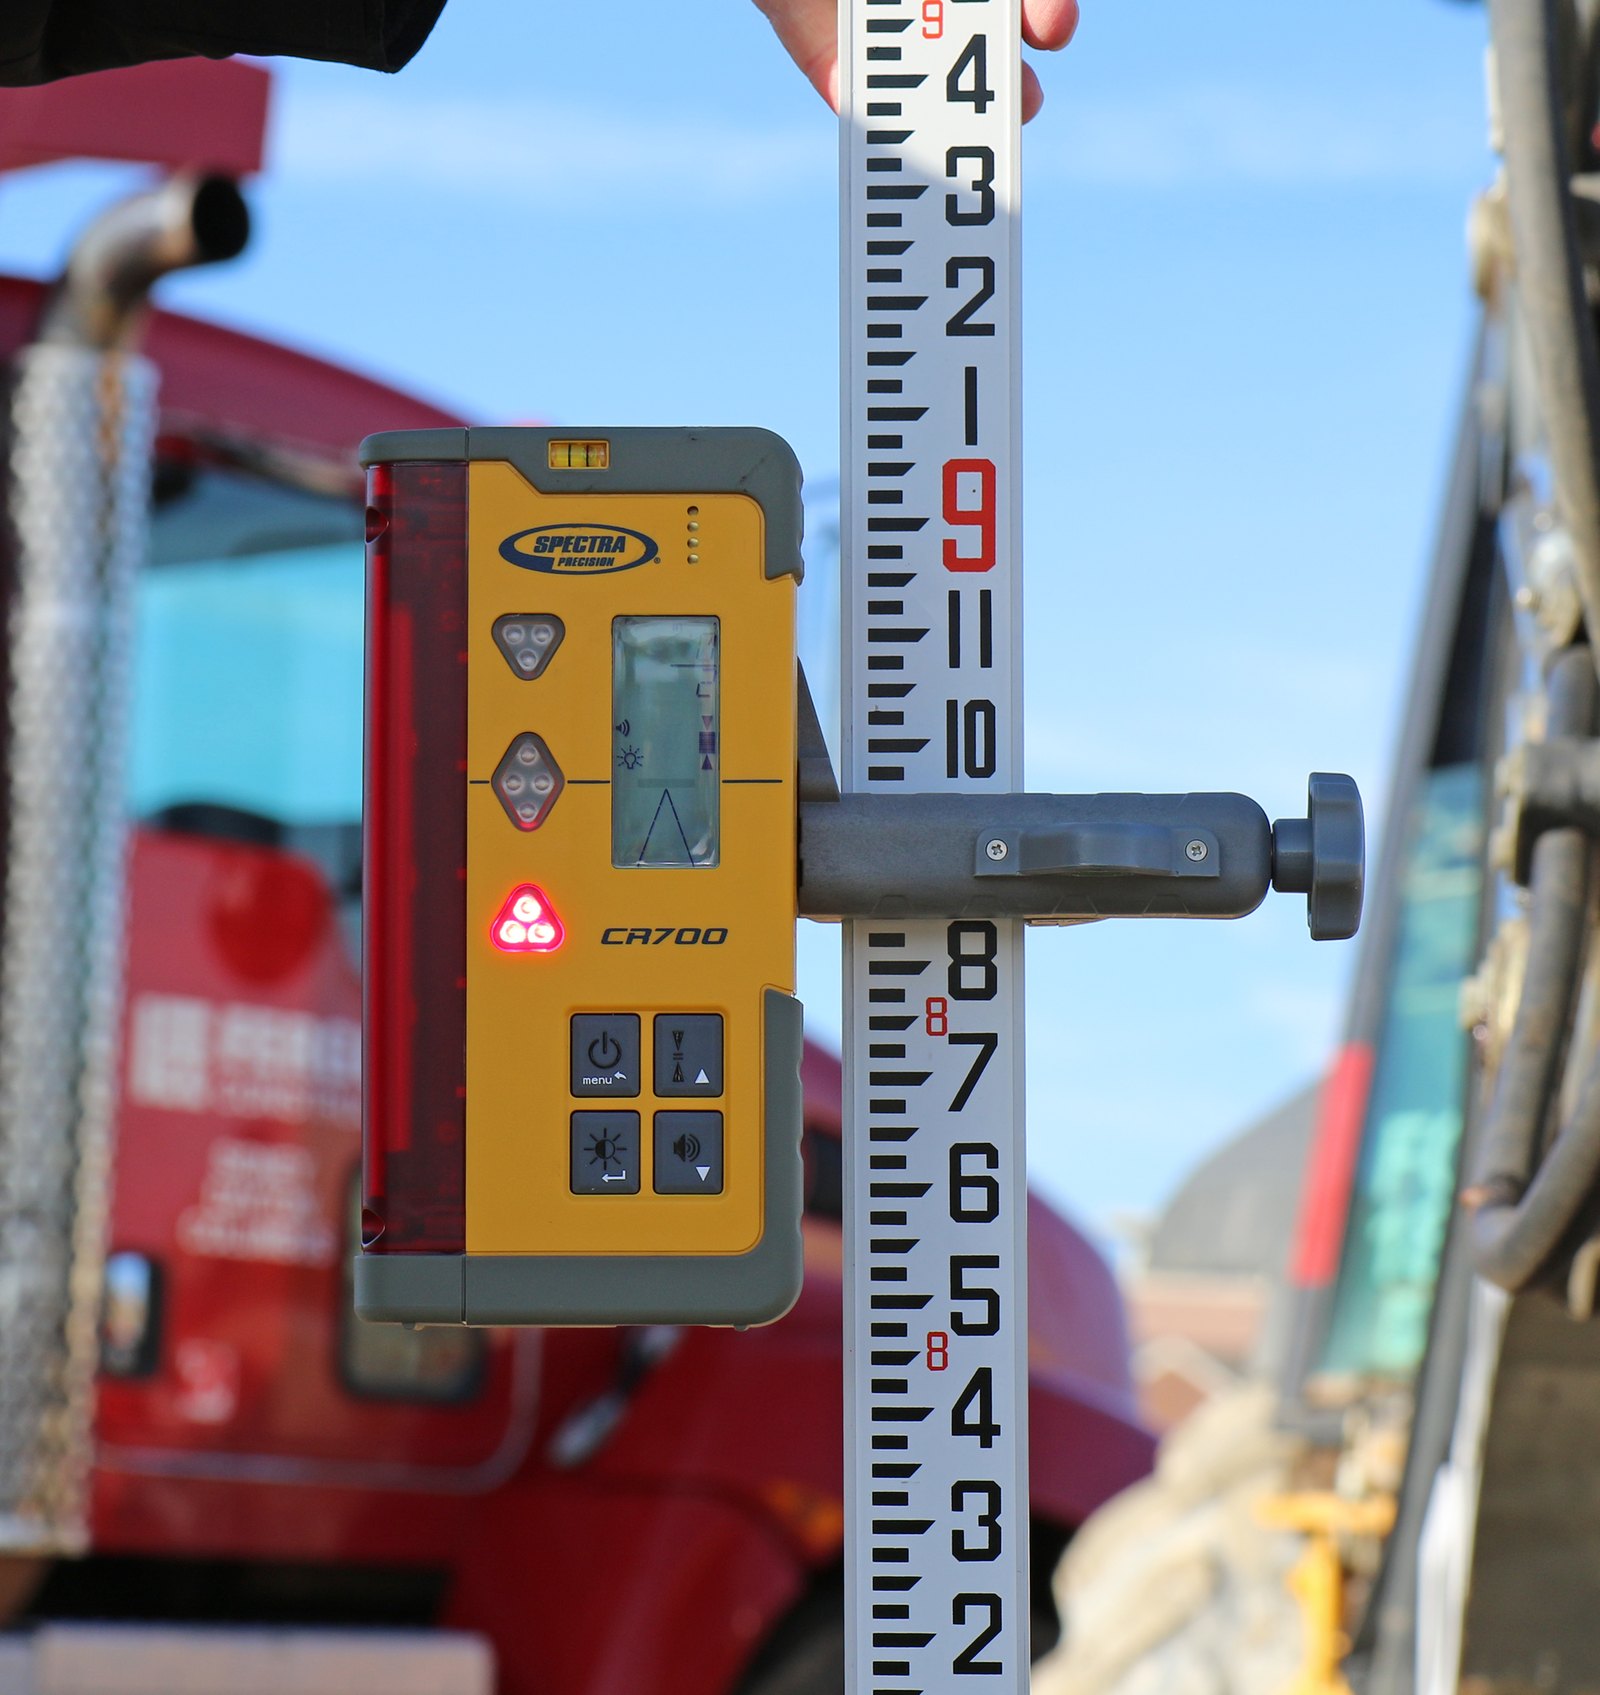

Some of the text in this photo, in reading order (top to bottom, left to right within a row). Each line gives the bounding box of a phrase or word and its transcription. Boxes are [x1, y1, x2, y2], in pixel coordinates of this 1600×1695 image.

[922, 0, 943, 39] 9
[946, 34, 995, 114] 4
[945, 146, 995, 226] 3
[945, 256, 995, 337] 2
[964, 366, 978, 446] 1
[533, 536, 626, 553] SPECTRA
[942, 458, 996, 573] 9
[557, 557, 615, 567] PRECISION
[948, 589, 993, 669] 11
[946, 699, 996, 779] 10
[601, 928, 728, 945] CR700
[947, 920, 998, 1001] 8
[926, 997, 948, 1037] 8
[582, 1076, 613, 1085] menu
[948, 1033, 998, 1112] 7
[950, 1142, 999, 1223] 6
[950, 1255, 1000, 1336] 5
[927, 1331, 948, 1371] 8
[951, 1367, 1001, 1448] 4
[951, 1480, 1002, 1562] 3
[952, 1593, 1003, 1675] 2
